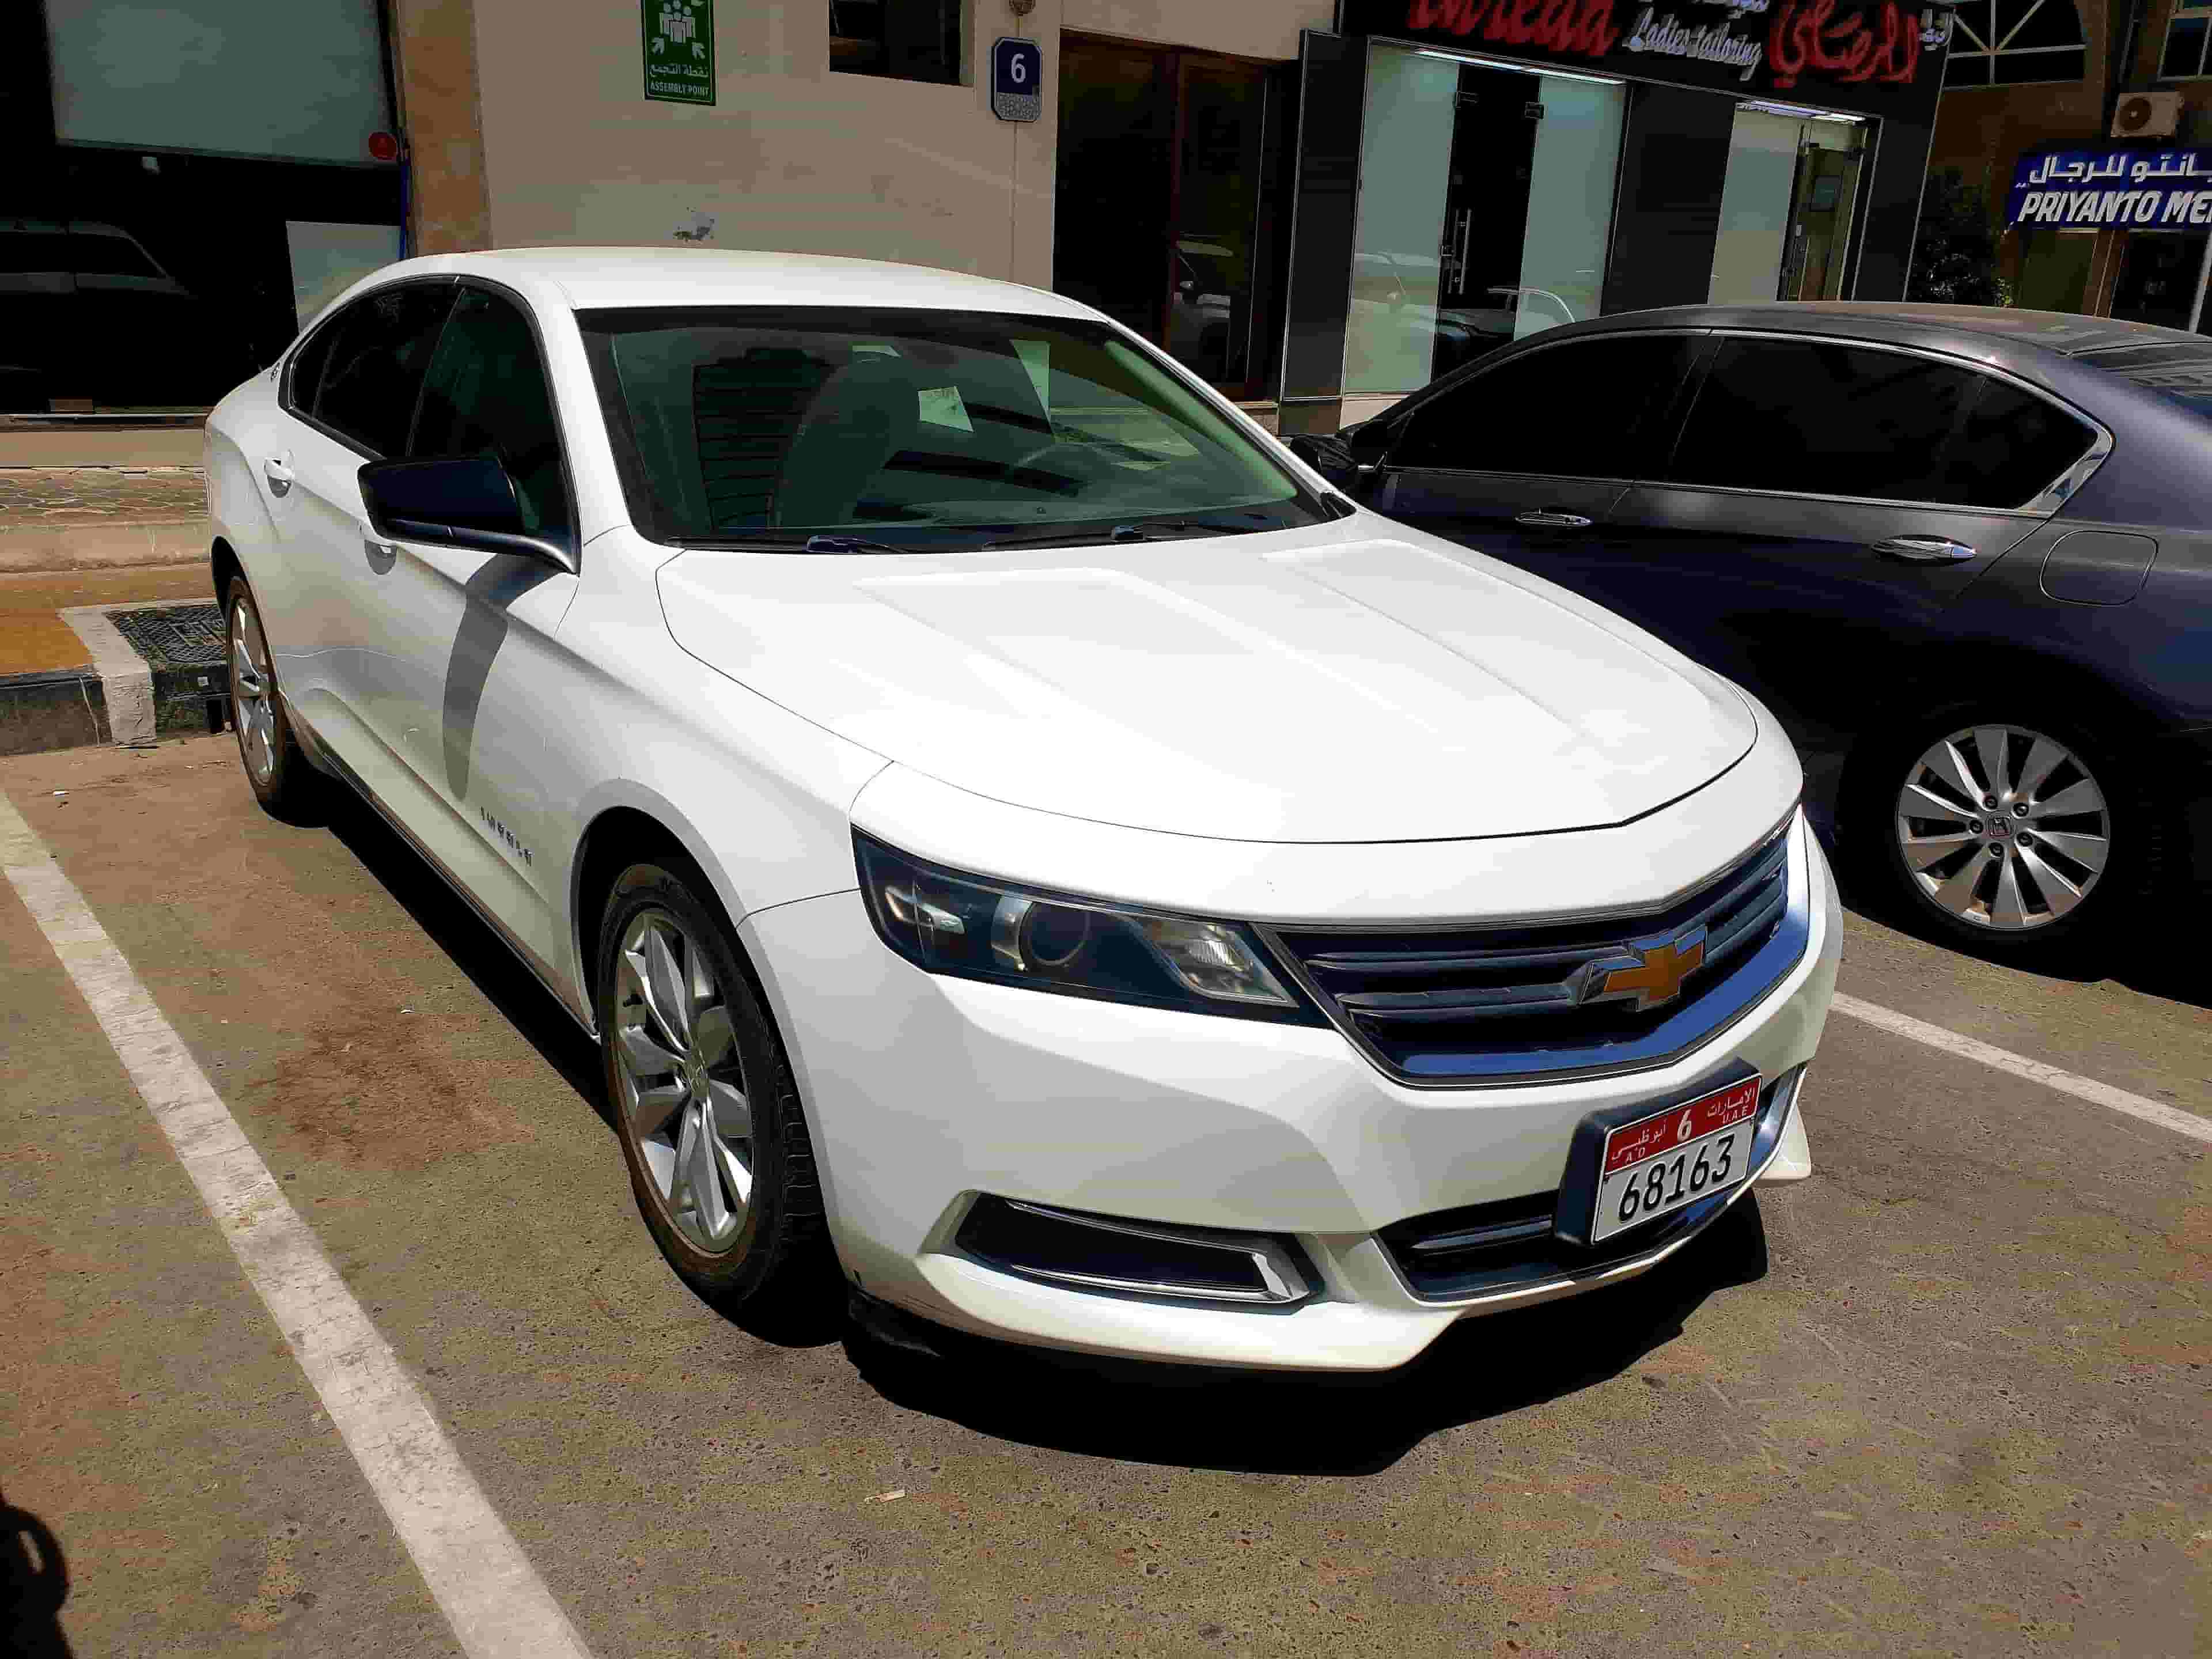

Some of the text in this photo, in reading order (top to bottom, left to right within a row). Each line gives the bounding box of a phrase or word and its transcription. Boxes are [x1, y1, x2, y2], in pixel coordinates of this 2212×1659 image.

[1011, 53, 1027, 84] 6
[687, 84, 710, 97] POINT
[2017, 191, 2162, 222] PRIYANTO
[1677, 1109, 1692, 1142] 6
[1618, 1132, 1734, 1221] 68163
